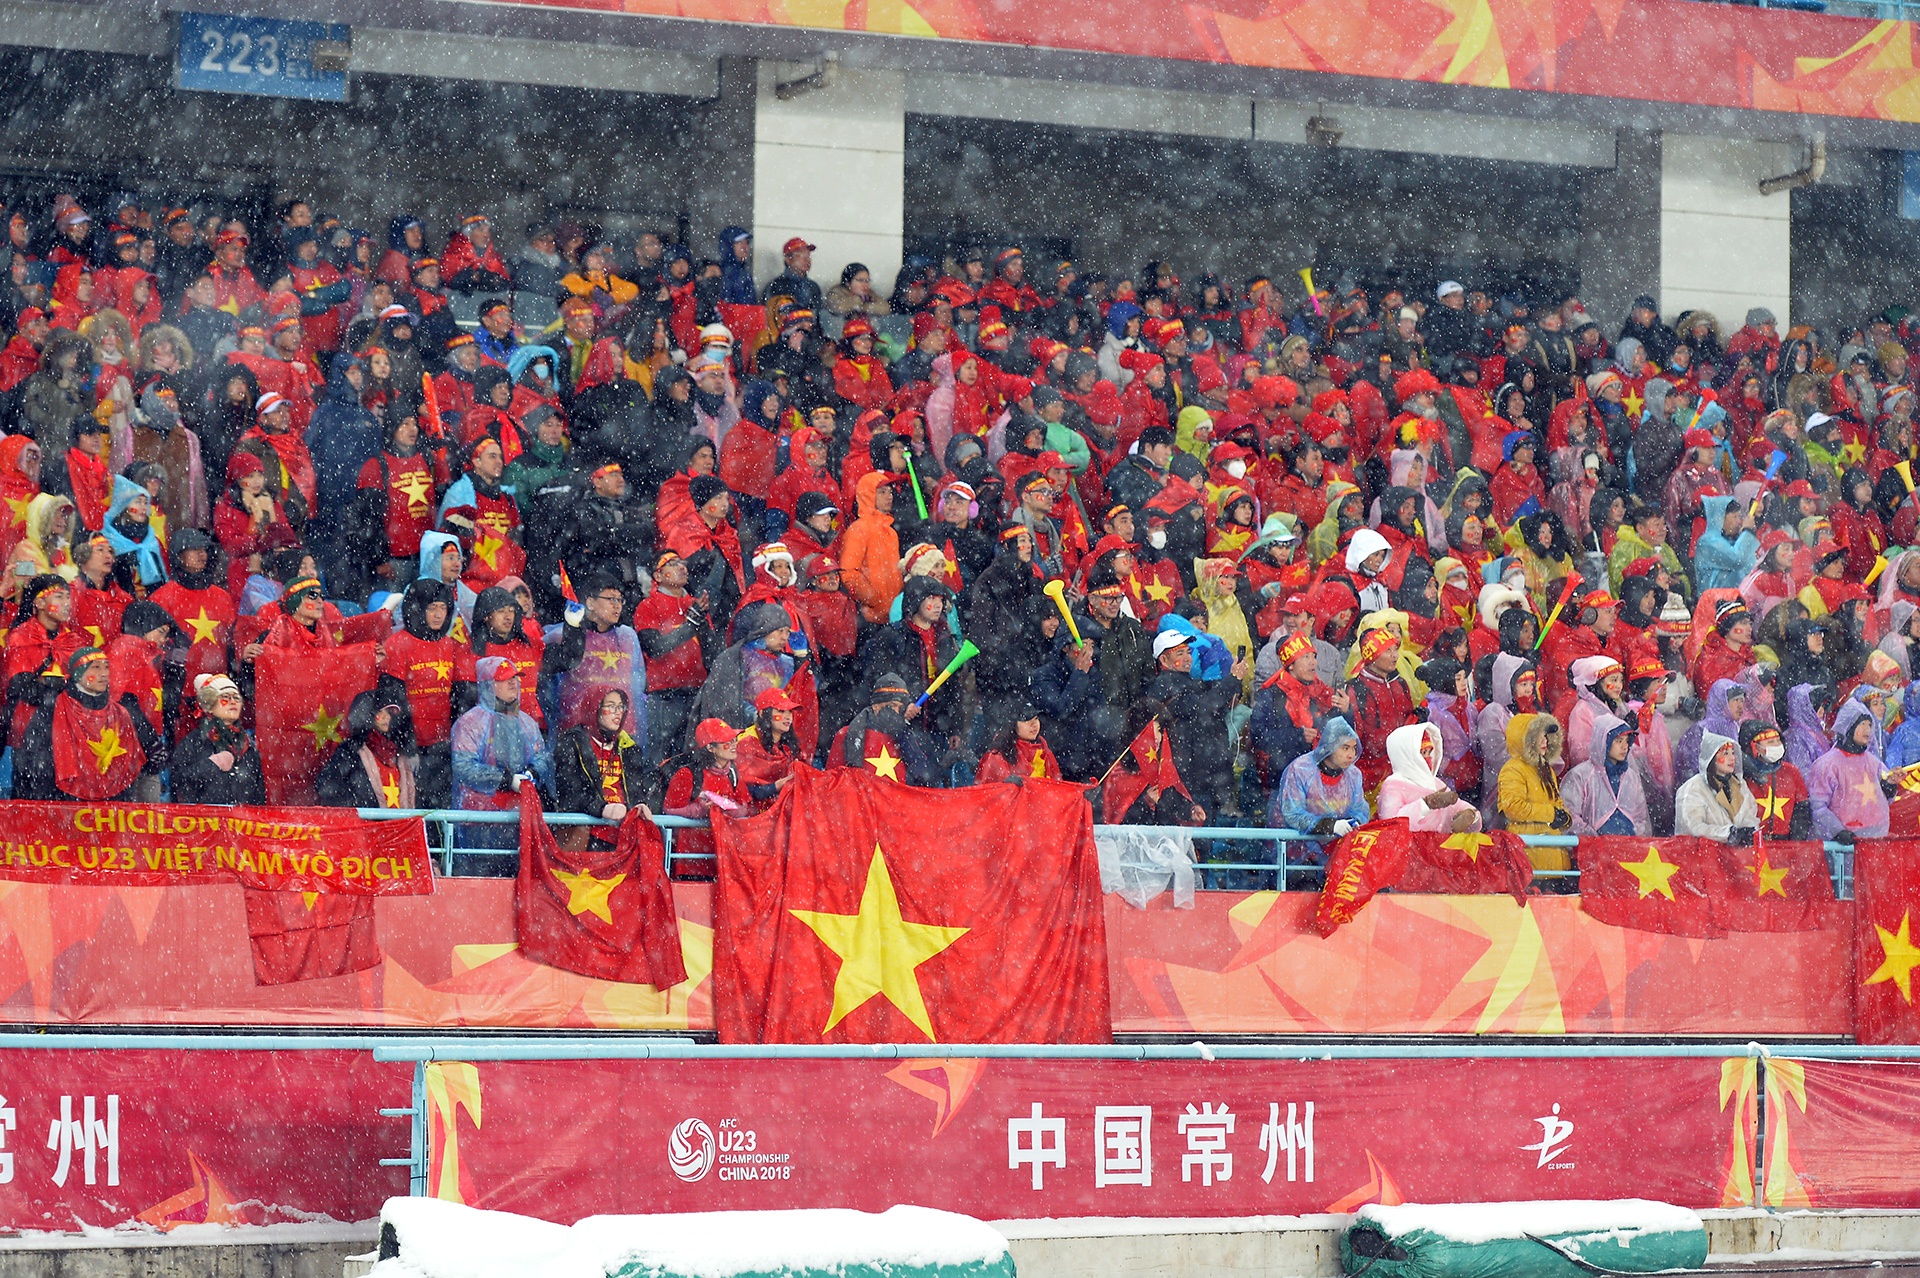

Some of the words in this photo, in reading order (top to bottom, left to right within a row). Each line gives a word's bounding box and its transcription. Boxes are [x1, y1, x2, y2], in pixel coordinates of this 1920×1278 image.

[200, 30, 280, 76] 223
[75, 808, 219, 834] CHICILON
[227, 817, 321, 842] MEDIA
[77, 846, 136, 870] U23
[142, 842, 209, 876] VIỆT
[215, 846, 284, 876] NAM
[289, 850, 334, 877] VÔ
[719, 1118, 737, 1128] AFC
[718, 1130, 757, 1152] U23
[1008, 1101, 1315, 1190] 中国常州
[718, 1153, 790, 1164] CHAMPIONSHIP
[718, 1166, 759, 1181] CHINA
[760, 1166, 791, 1180] 2018
